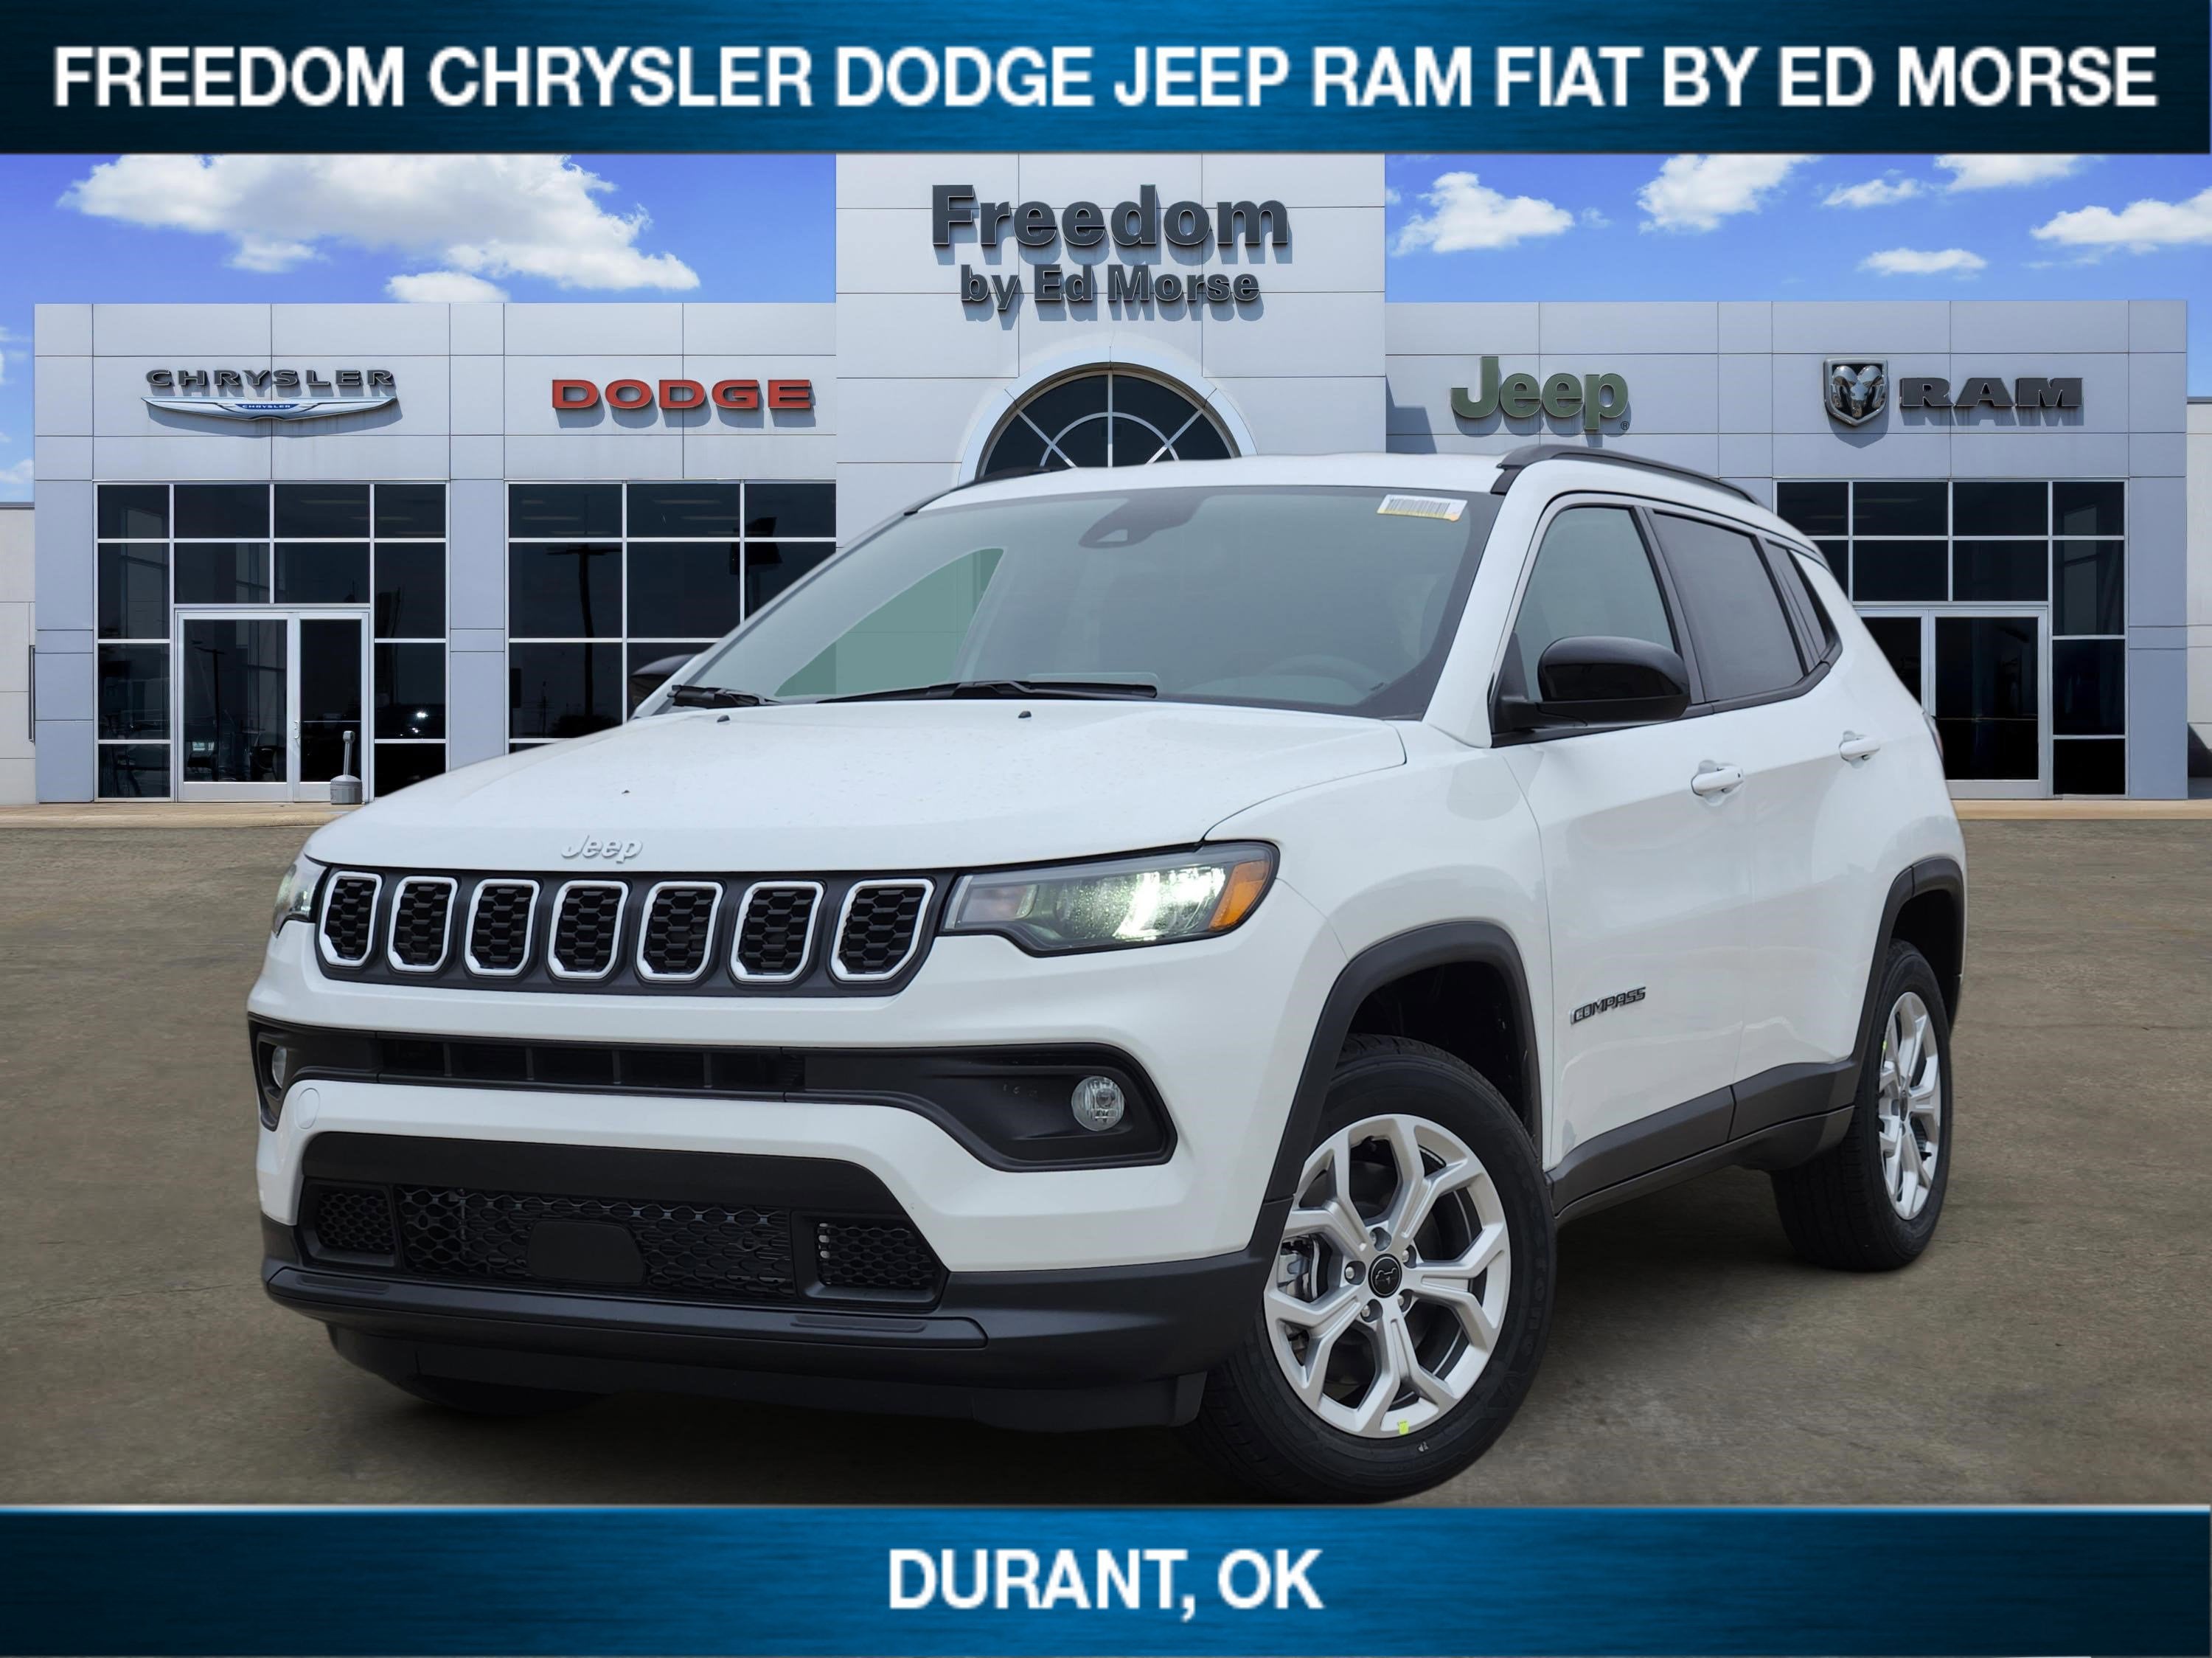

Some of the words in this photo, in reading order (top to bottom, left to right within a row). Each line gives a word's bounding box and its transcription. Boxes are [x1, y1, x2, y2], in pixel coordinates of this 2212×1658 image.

[932, 184, 1290, 246] Freedom
[960, 264, 1020, 311] by
[1034, 264, 1093, 302] Ed
[1107, 264, 1261, 302] Morse
[145, 369, 394, 387] CHRYSLER
[552, 378, 813, 409] DODGE
[1450, 355, 1630, 431] Jeep
[1899, 377, 2084, 408] RAM
[560, 834, 644, 864] Jeep
[1570, 985, 1647, 1025] COMPASS
